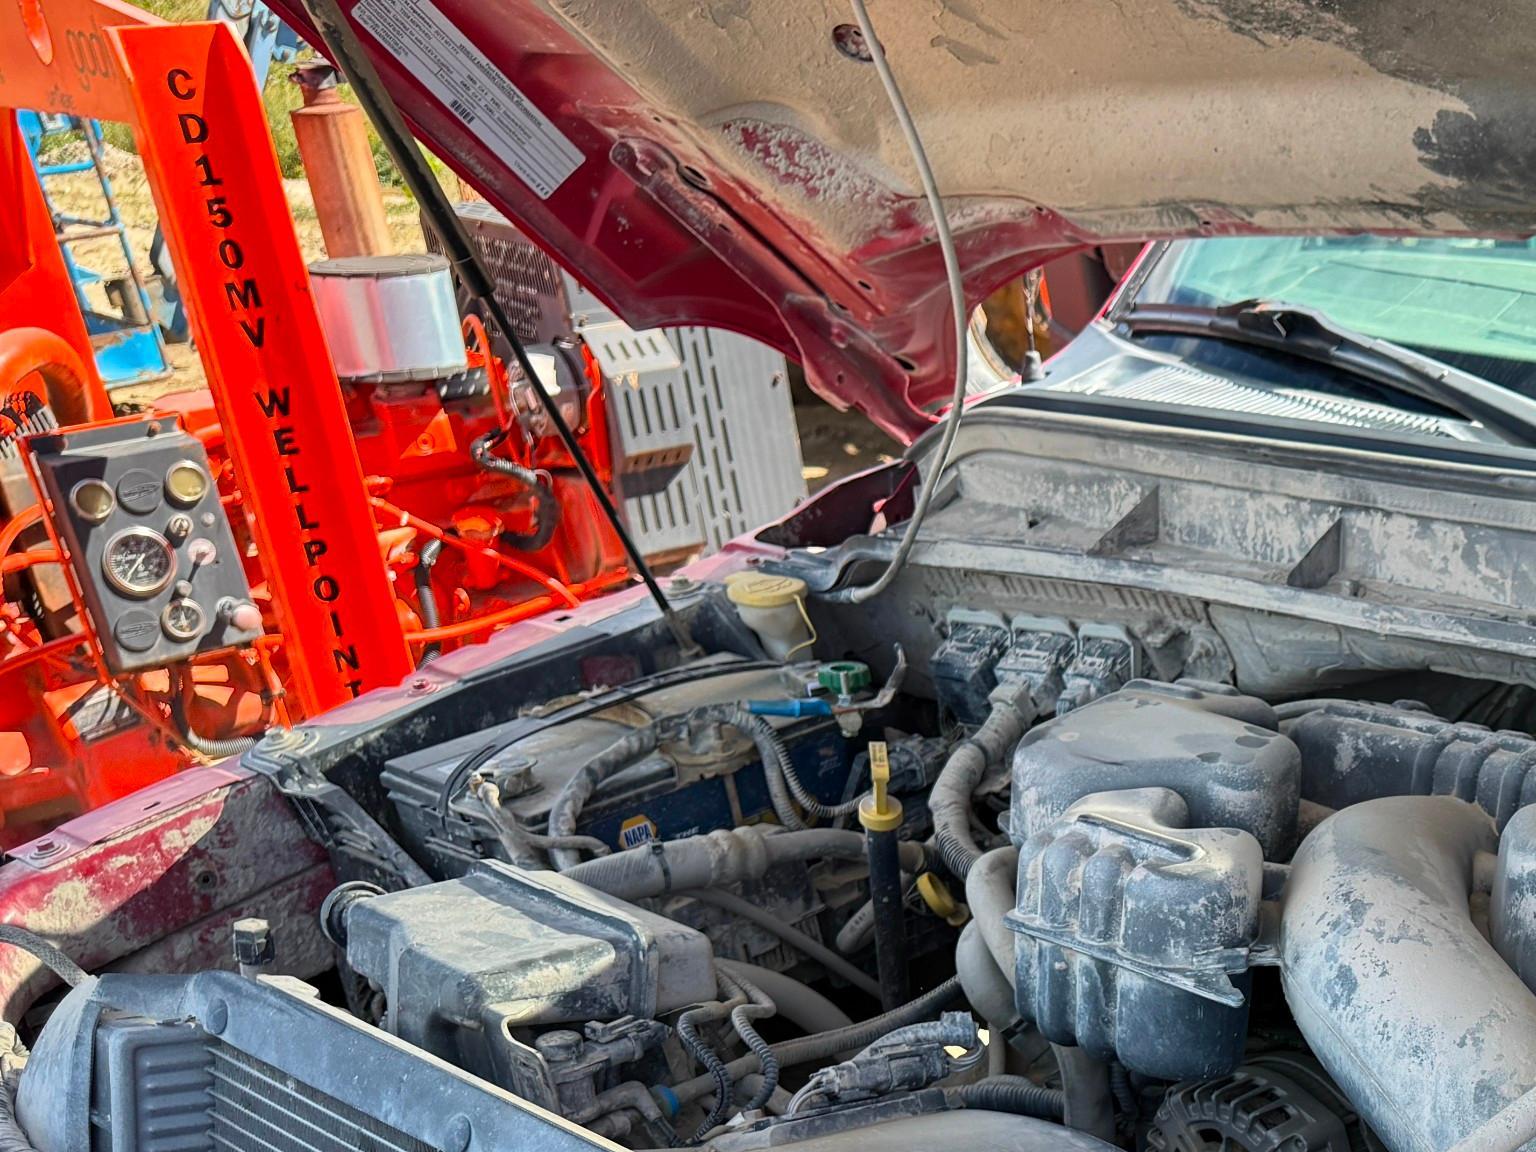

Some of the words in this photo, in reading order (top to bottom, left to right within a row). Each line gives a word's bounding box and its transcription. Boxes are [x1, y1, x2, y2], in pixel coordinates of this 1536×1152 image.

[166, 67, 265, 349] CD150MV
[254, 387, 361, 698] WELLPOINT
[624, 822, 653, 847] NAPA
